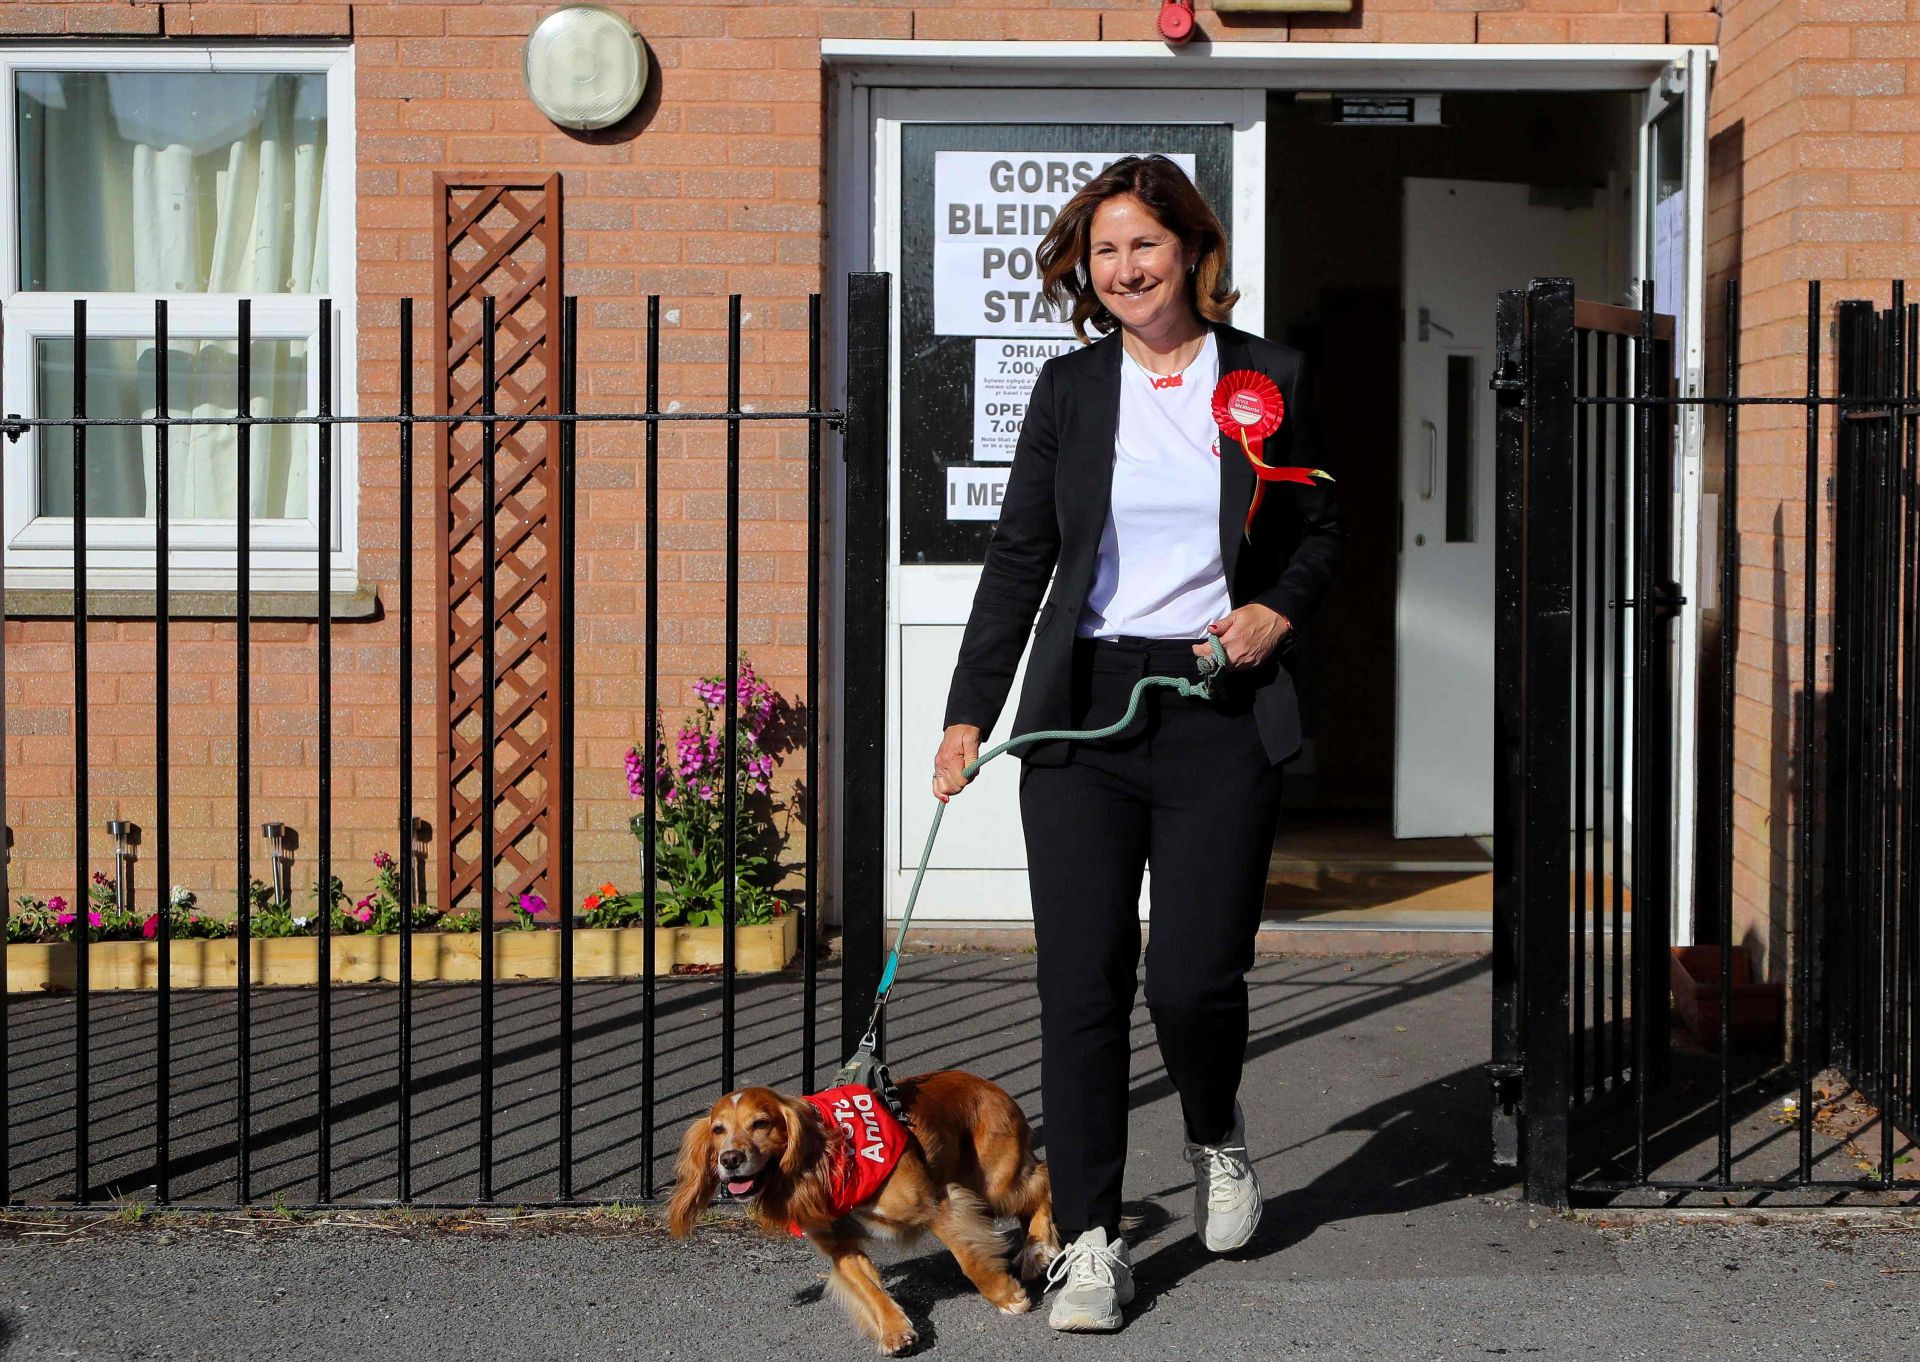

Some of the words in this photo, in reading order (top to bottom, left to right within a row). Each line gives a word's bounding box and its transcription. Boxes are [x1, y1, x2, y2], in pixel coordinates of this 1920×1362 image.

[949, 203, 1064, 235] BLEID
[983, 247, 1043, 280] PO
[1002, 344, 1060, 358] ORIAU
[950, 483, 956, 505] I
[967, 483, 1008, 506] ME
[852, 1094, 885, 1163] Anna
